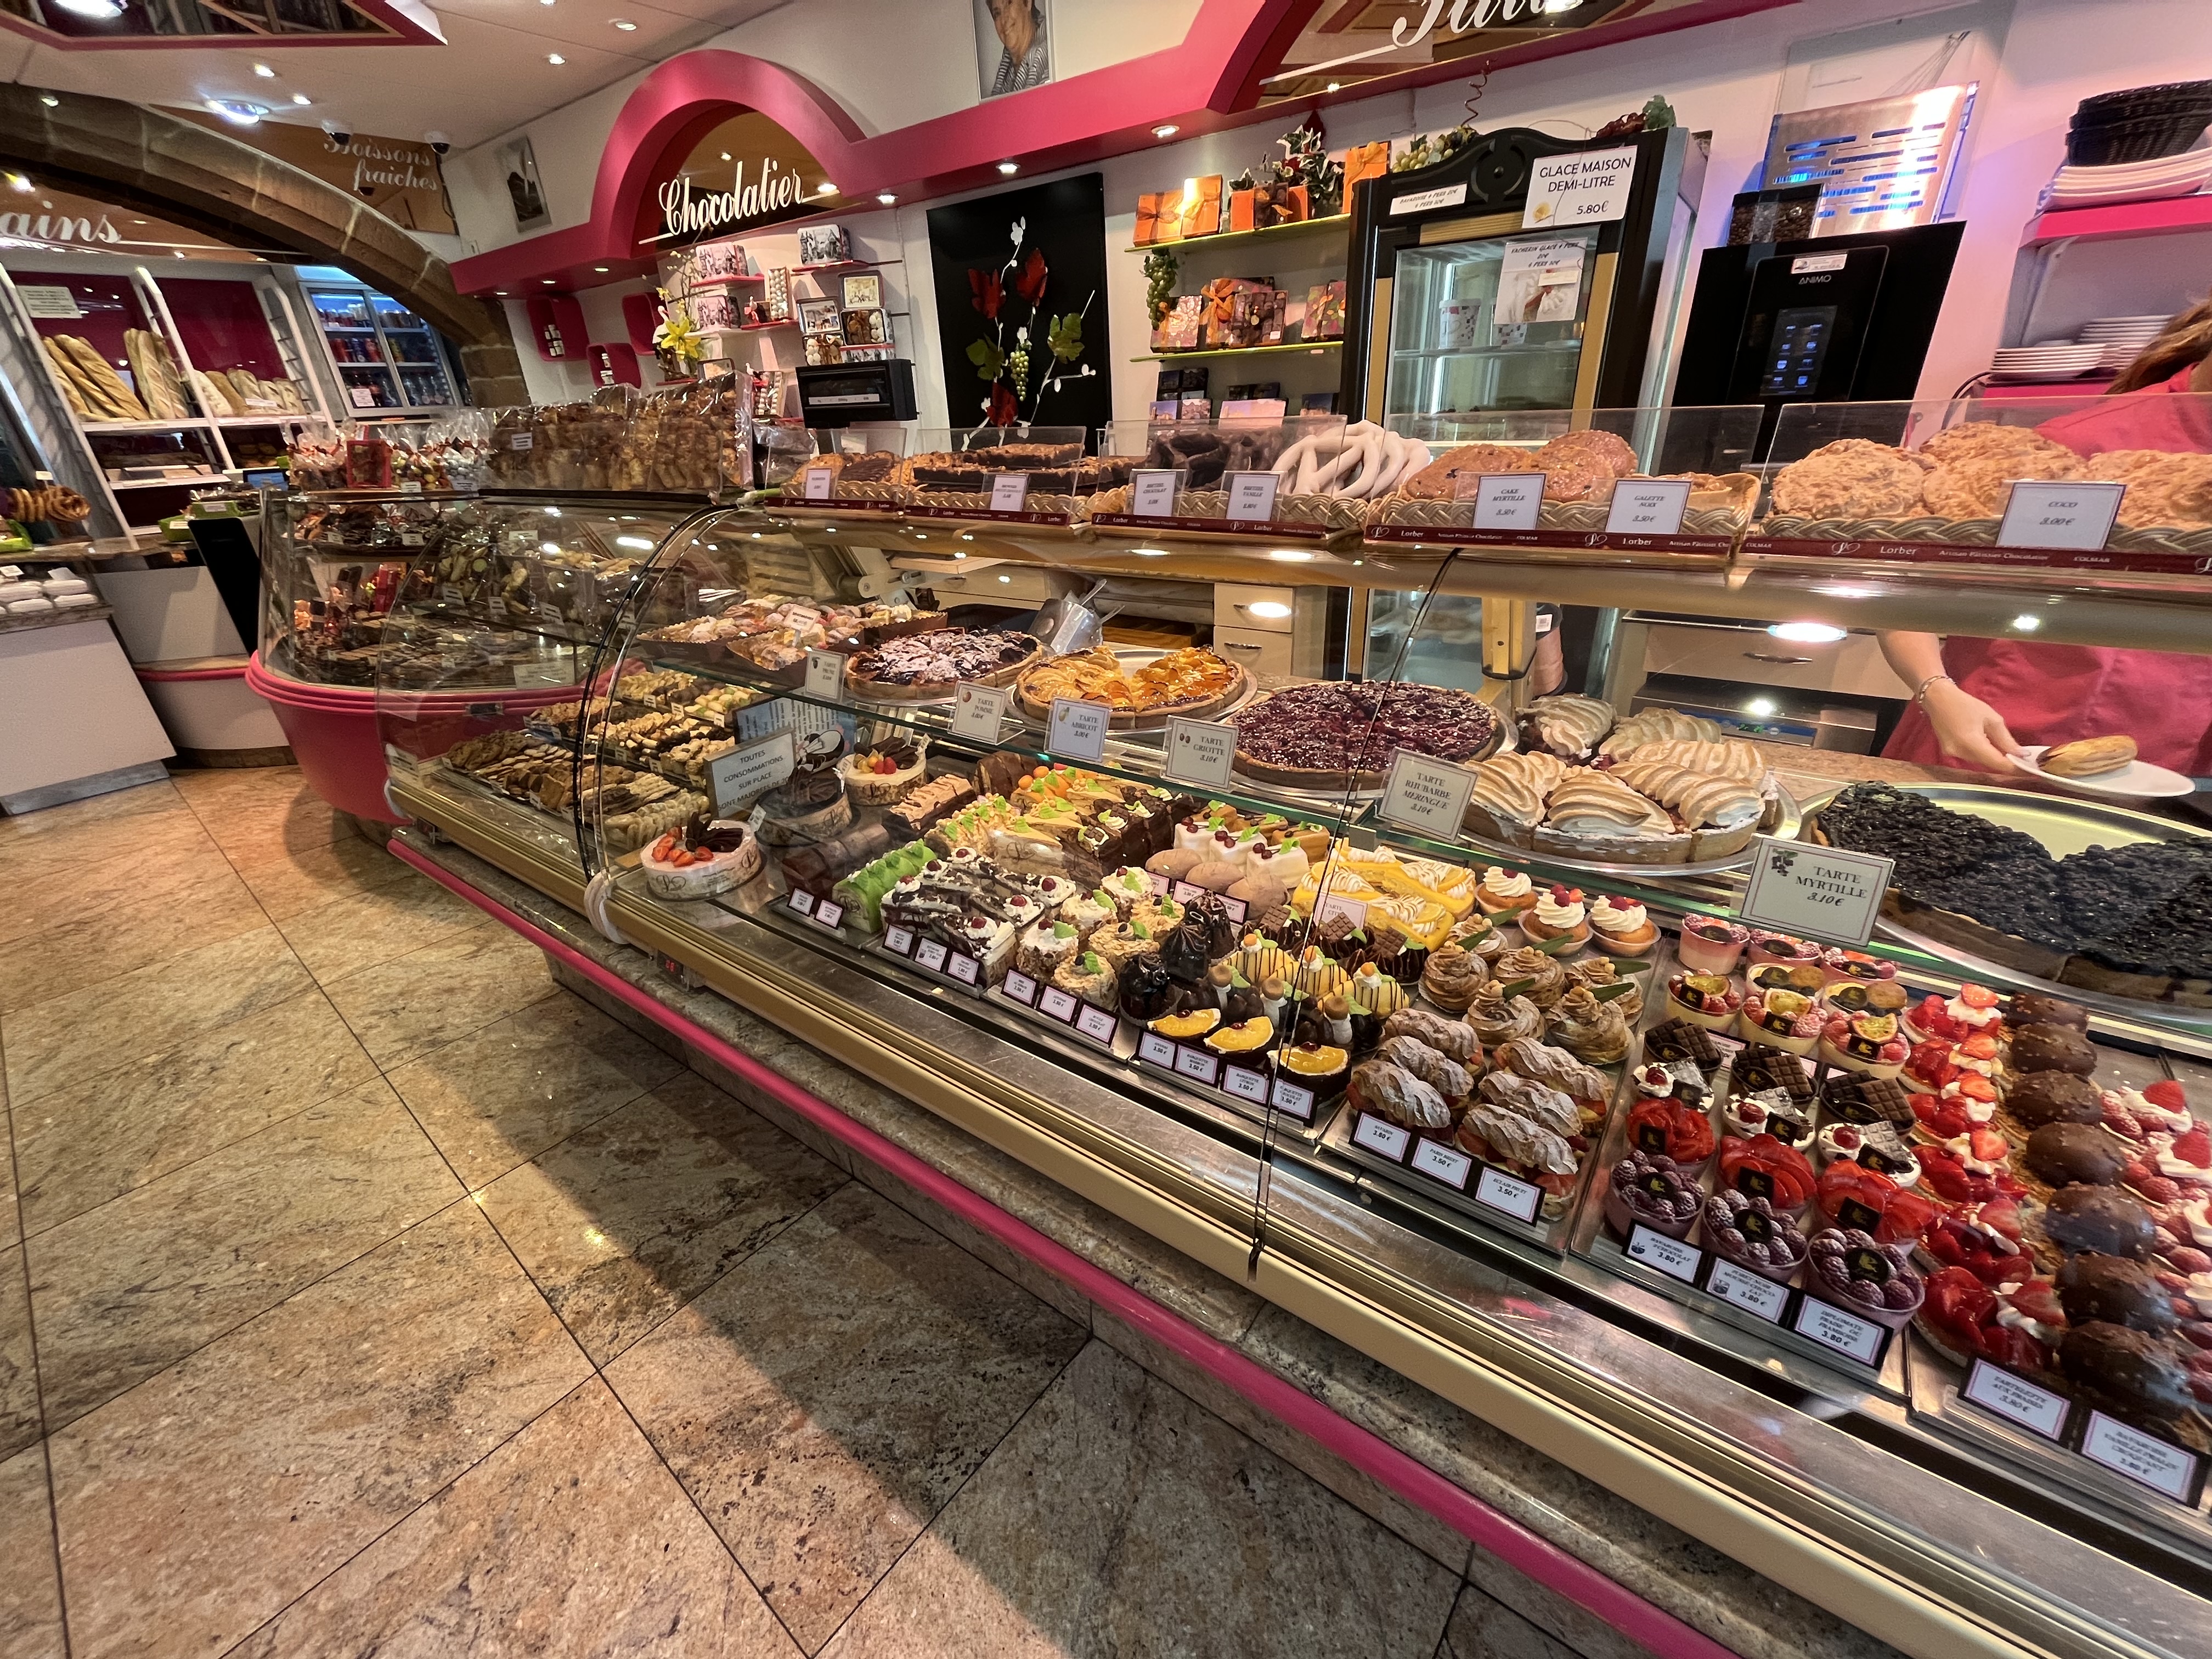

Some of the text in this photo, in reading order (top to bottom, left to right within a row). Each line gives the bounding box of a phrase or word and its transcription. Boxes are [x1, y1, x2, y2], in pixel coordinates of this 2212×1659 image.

[1540, 157, 1632, 178] GLACE MAISON
[353, 159, 437, 191] fraiches
[1548, 176, 1616, 193] DEMI-LITRE
[659, 157, 804, 235] Chocolatier
[1798, 275, 1832, 285] ANIMO
[1622, 538, 1652, 546] Lorber
[1880, 546, 1918, 555] Lorber
[978, 698, 994, 707] TARTE
[1079, 714, 1098, 723] TARTE
[1071, 721, 1098, 732] ABRICOT
[1200, 736, 1224, 746] TARTE
[740, 749, 766, 764] TOUTES
[1193, 744, 1225, 755] GRIOTTE
[724, 755, 783, 783] CONSOMMATIONS
[738, 771, 772, 790] SUR PLACE
[1417, 772, 1446, 787] TARTE
[1405, 780, 1452, 800] RHUBARBE
[718, 799, 736, 811] SONT
[1813, 866, 1861, 884] TARTE
[1796, 876, 1867, 898] MYRTILLE
[1807, 892, 1845, 906] 3.10€
[1430, 1148, 1459, 1164] PARIS BREST
[1432, 1155, 1446, 1166] 3.50
[1493, 1178, 1527, 1194] ECLAIR FRUIT
[1498, 1186, 1513, 1196] 3.50
[1657, 1252, 1675, 1262] 3.80
[1724, 1272, 1750, 1284] MOUSSE
[1740, 1291, 1759, 1303] 3.80
[1820, 1316, 1845, 1329] FRAISE
[1821, 1311, 1864, 1331] DIPLOMATE
[1818, 1322, 1858, 1342] FRAMBOISE
[1821, 1330, 1842, 1343] 3.80
[1992, 1384, 2044, 1409] AUX FRAISES
[1994, 1376, 2048, 1404] TARTELETTE
